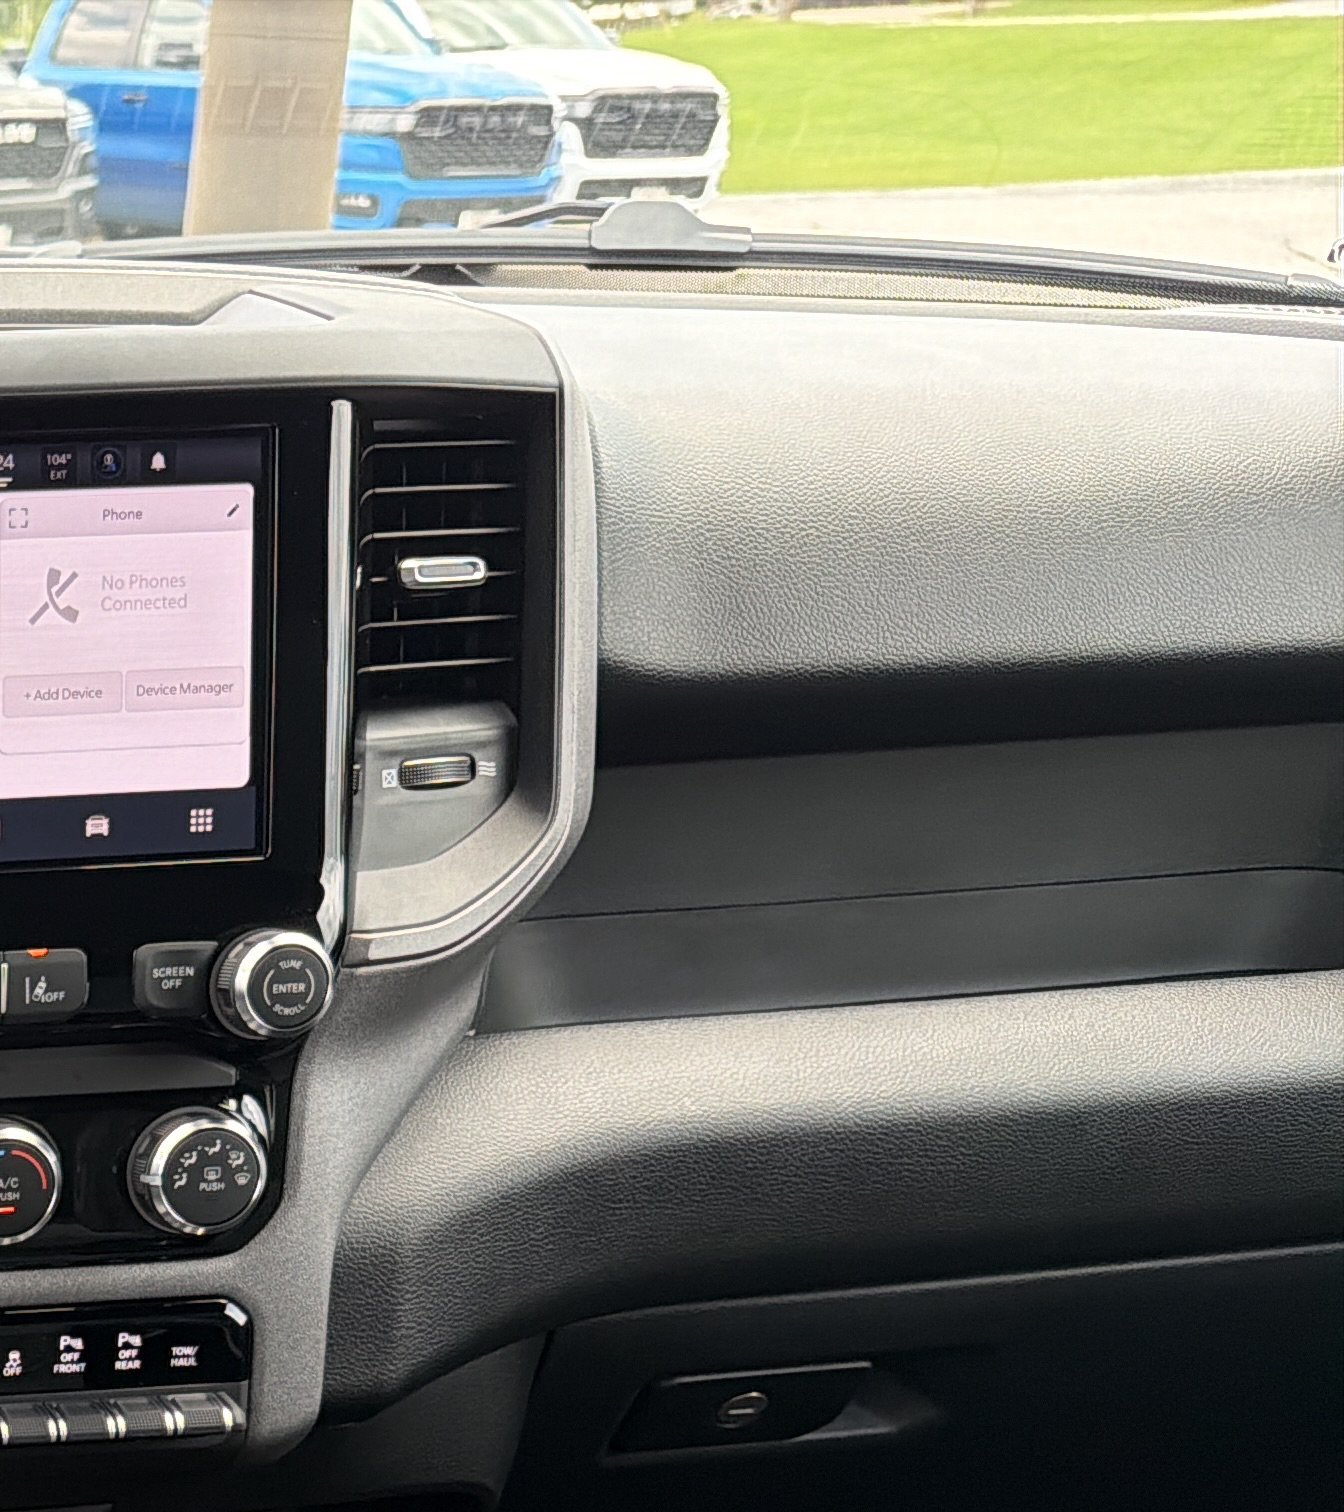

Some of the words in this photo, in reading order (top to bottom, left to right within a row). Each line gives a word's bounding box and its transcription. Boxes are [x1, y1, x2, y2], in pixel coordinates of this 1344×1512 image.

[50, 470, 67, 480] EXT
[102, 508, 143, 522] Phone
[101, 575, 125, 591] No
[128, 573, 187, 589] Phones
[100, 593, 188, 612] Connected
[33, 689, 59, 701] Add
[62, 687, 103, 700] Device
[136, 684, 177, 697] Device
[179, 683, 234, 699] Manager
[278, 958, 302, 971] TUNE
[152, 965, 195, 979] SCREEN
[161, 978, 183, 990] OFF
[272, 982, 306, 995] ENTER
[45, 991, 66, 1003] OFF
[271, 1002, 307, 1016] SCROLL
[199, 1181, 226, 1192] PUSH
[60, 1351, 81, 1363] OFF
[118, 1349, 140, 1360] OFF
[170, 1345, 200, 1357] TOW/
[114, 1360, 142, 1371] REAR
[170, 1356, 199, 1367] HAUL
[2, 1367, 23, 1377] OFF
[53, 1362, 87, 1374] FRONT
